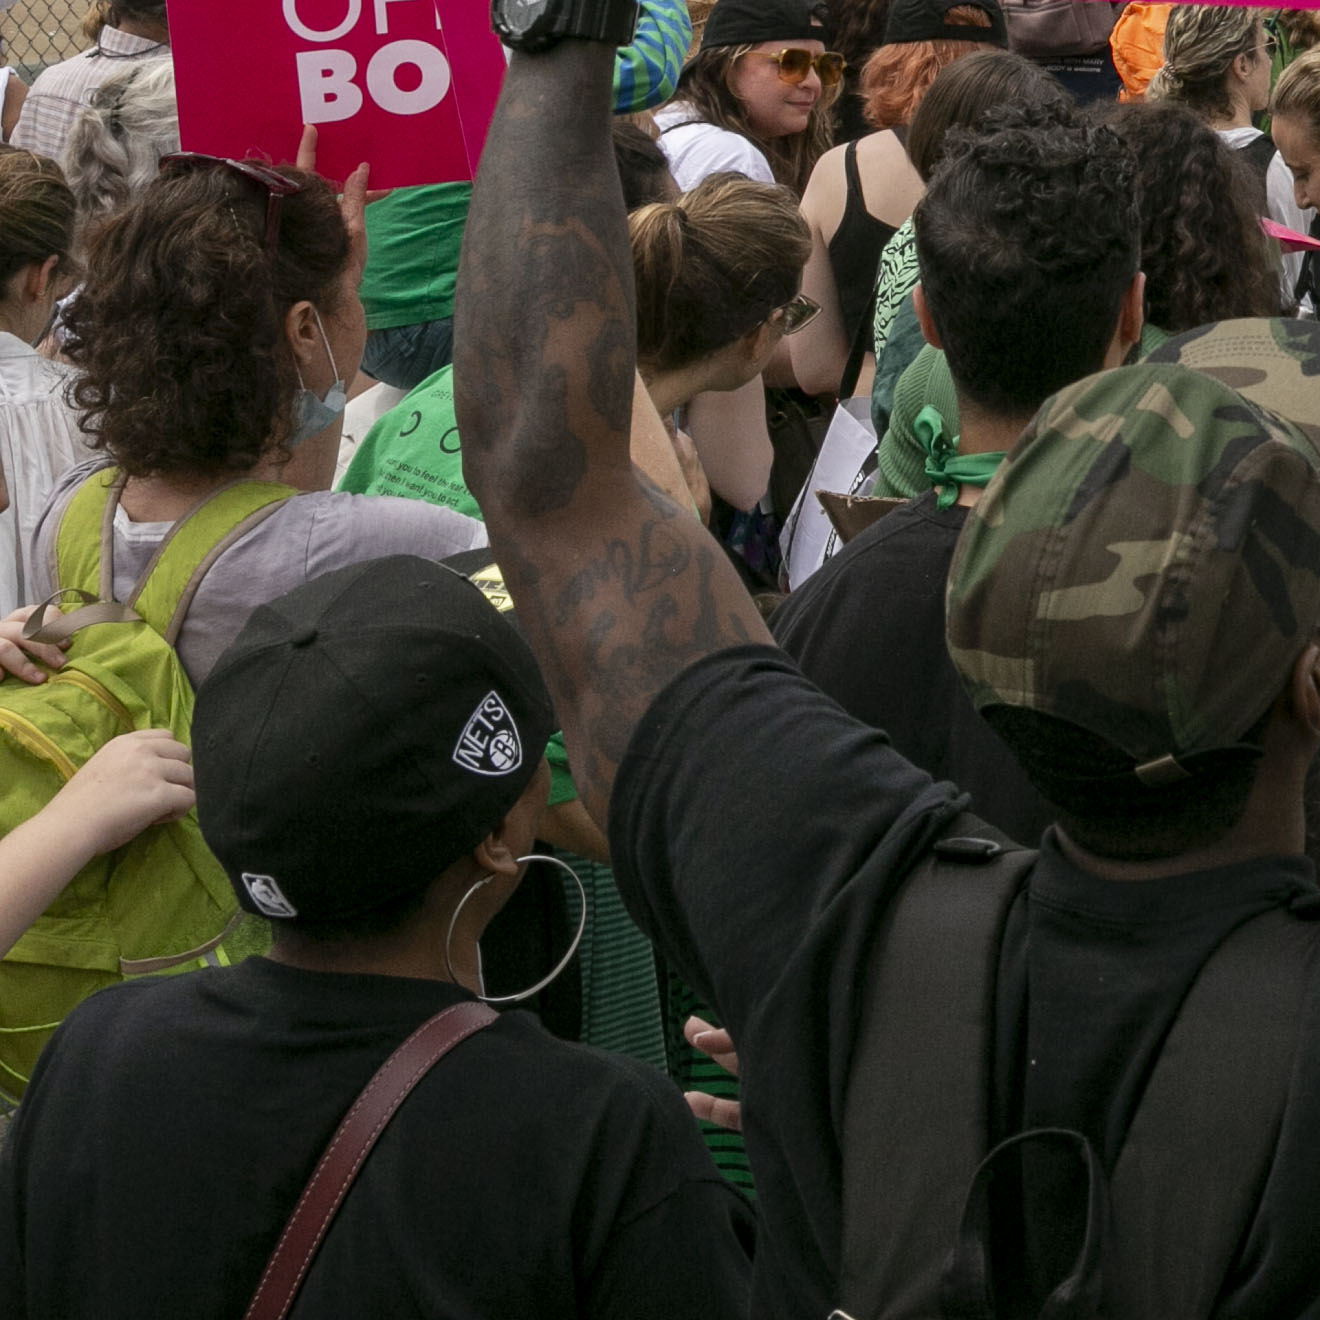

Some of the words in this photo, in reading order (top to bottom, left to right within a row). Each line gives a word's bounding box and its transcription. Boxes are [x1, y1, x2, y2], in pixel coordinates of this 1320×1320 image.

[296, 39, 451, 125] BO
[458, 697, 504, 768] NETS
[494, 738, 515, 760] B
